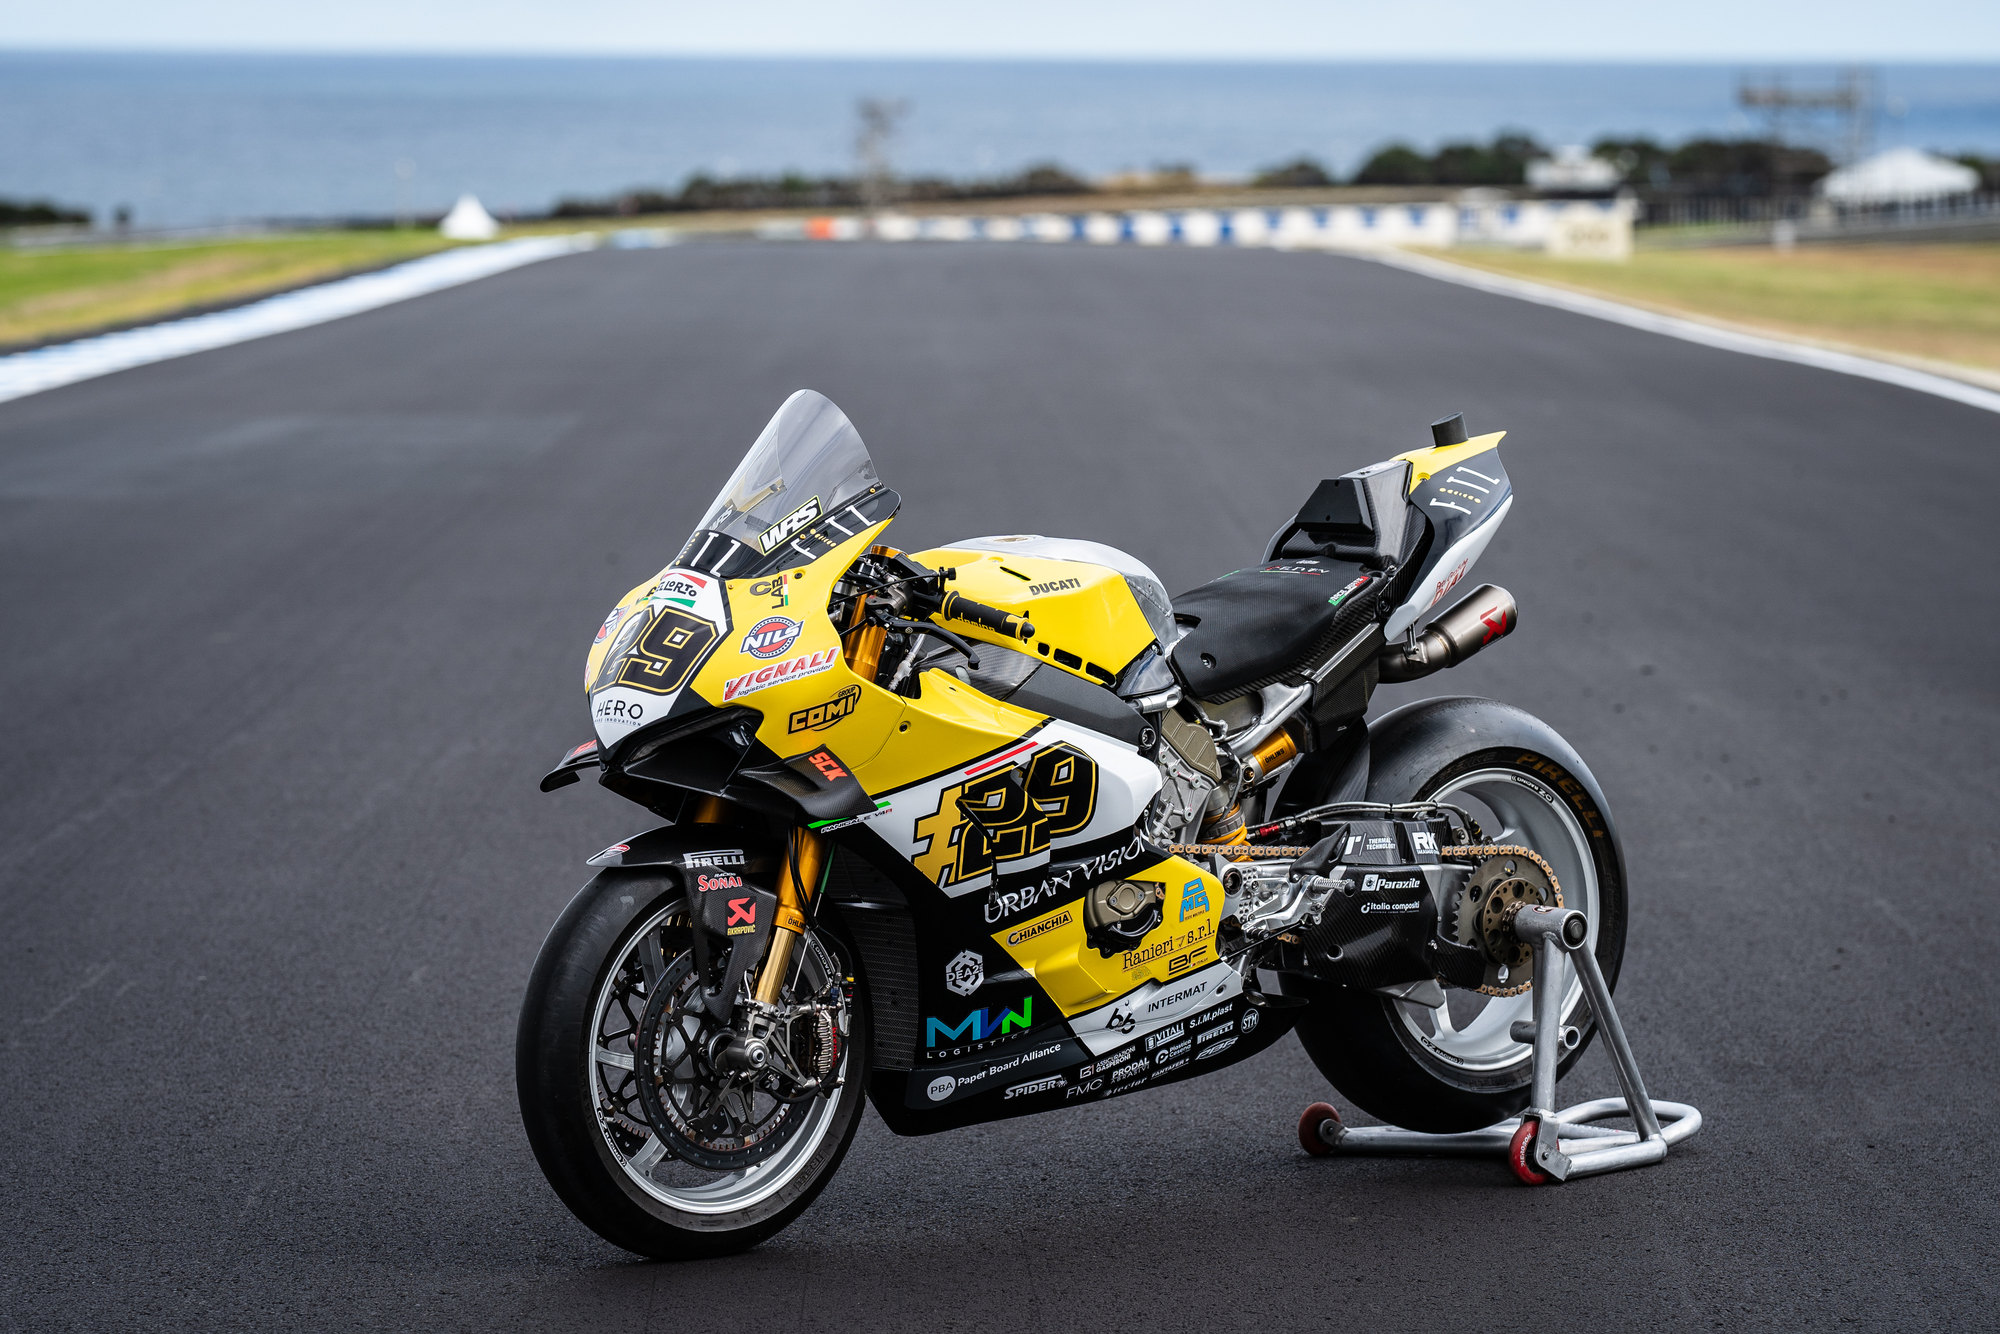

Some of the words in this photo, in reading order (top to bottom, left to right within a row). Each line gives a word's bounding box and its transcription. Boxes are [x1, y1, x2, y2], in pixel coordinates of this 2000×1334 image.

[760, 499, 818, 553] WRS
[772, 574, 784, 609] LAB
[1029, 578, 1081, 595] DUCATI
[592, 604, 719, 696] 29
[742, 623, 801, 652] NILS
[725, 648, 837, 700] VIGNALI
[737, 682, 766, 696] logistic
[767, 675, 797, 687] service
[797, 664, 833, 679] provider
[837, 686, 857, 698] GROUP
[596, 699, 644, 720] HERO
[790, 696, 856, 732] COMI
[808, 751, 849, 782] SCK
[1516, 753, 1604, 838] PIRELLI
[1412, 832, 1438, 850] RK
[682, 849, 746, 869] PIRELLI
[983, 870, 1073, 924] URBAN
[1006, 912, 1072, 947] CHIANCHIA
[1122, 935, 1175, 970] Ranieri
[1147, 981, 1208, 1013] INTERMAT
[1155, 1023, 1184, 1041] VITALI
[1197, 1021, 1234, 1044] PIRELLI
[1243, 1012, 1258, 1030] STM
[930, 1082, 954, 1096] PBA
[957, 1071, 987, 1087] Paper
[989, 1057, 1020, 1076] Board
[1021, 1043, 1062, 1064] Alliance
[1112, 1057, 1150, 1078] PRODAL
[1004, 1075, 1057, 1100] SPIDER
[1066, 1077, 1104, 1099] FMC
